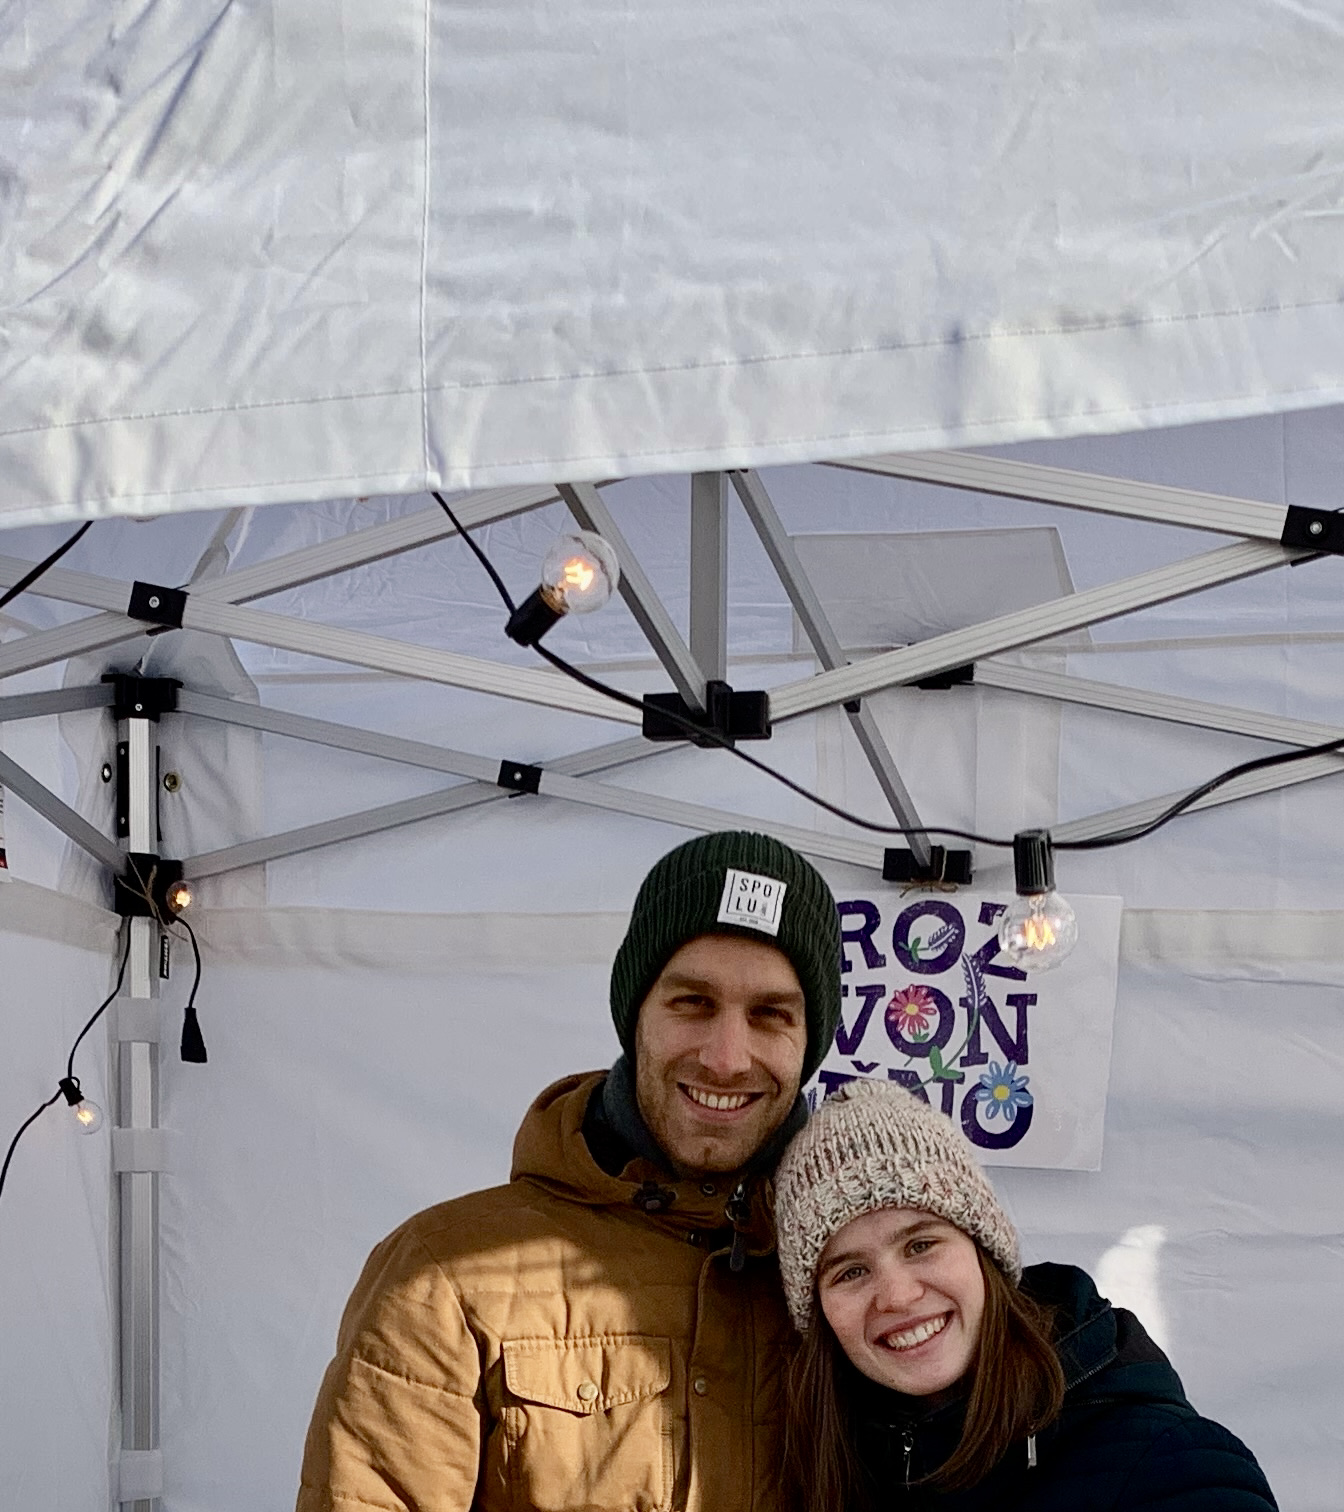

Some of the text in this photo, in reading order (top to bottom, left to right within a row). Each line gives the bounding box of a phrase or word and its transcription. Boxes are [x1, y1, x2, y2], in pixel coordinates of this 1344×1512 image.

[739, 877, 773, 898] SPO
[838, 900, 1029, 981] ROZ
[834, 984, 1037, 1066] VON
